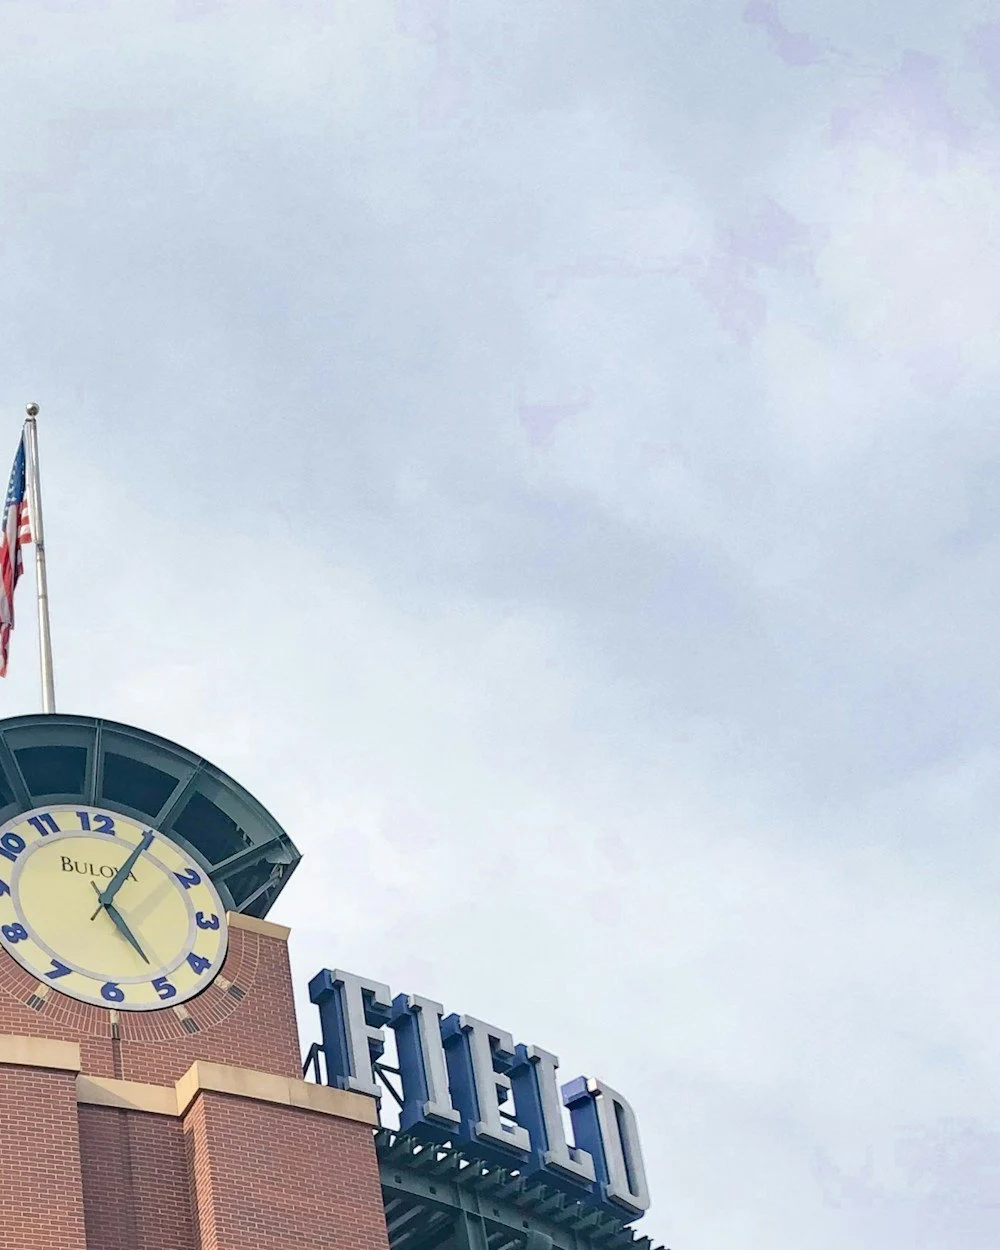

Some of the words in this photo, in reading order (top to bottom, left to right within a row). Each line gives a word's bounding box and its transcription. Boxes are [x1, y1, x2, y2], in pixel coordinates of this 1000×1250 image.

[27, 812, 61, 836] 11
[77, 812, 115, 836] 12
[60, 856, 139, 882] BULOA
[172, 868, 201, 890] 2
[195, 911, 220, 931] 3
[1, 923, 28, 944] 8
[44, 959, 73, 980] 7
[186, 952, 212, 975] 4
[100, 981, 125, 1002] 6
[151, 977, 177, 1000] 5
[316, 968, 651, 1214] FIELD
